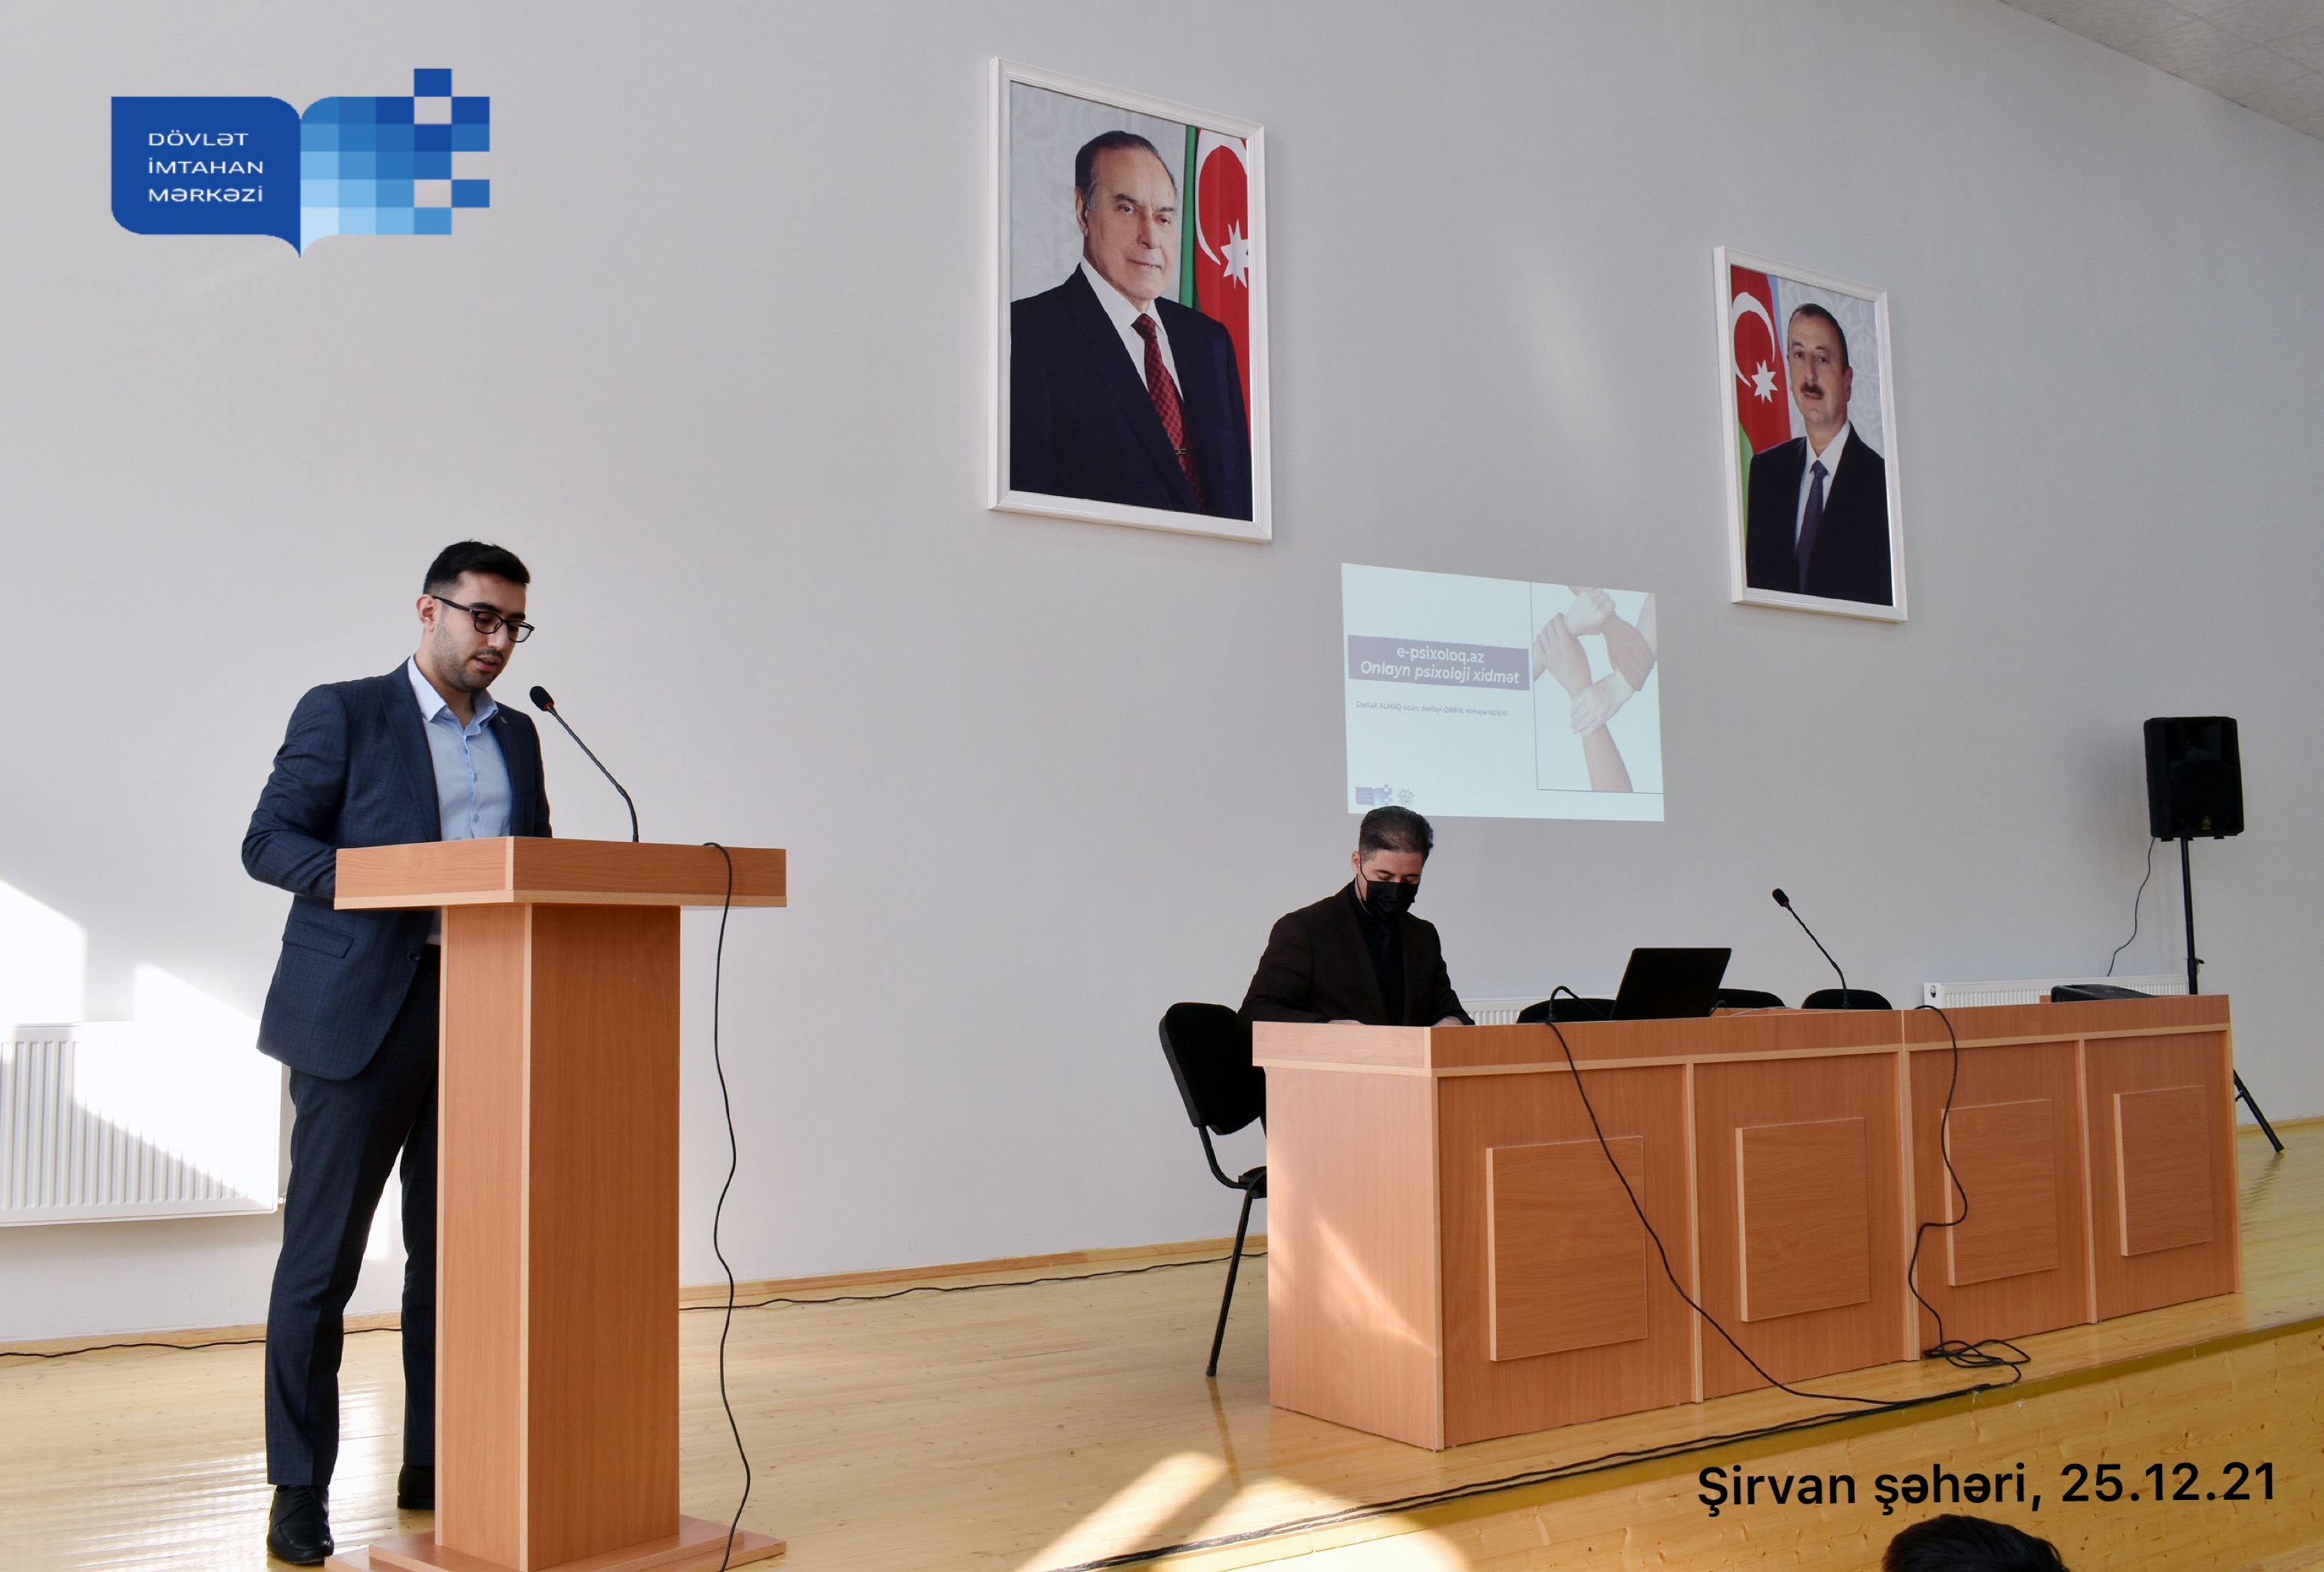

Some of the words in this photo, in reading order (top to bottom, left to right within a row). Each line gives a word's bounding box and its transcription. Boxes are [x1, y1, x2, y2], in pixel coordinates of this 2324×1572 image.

[1397, 646, 1485, 665] e-psixoloq.az
[1361, 660, 1411, 679] Onlayn
[1415, 663, 1471, 684] psixoloji
[1473, 668, 1520, 684] xidmət
